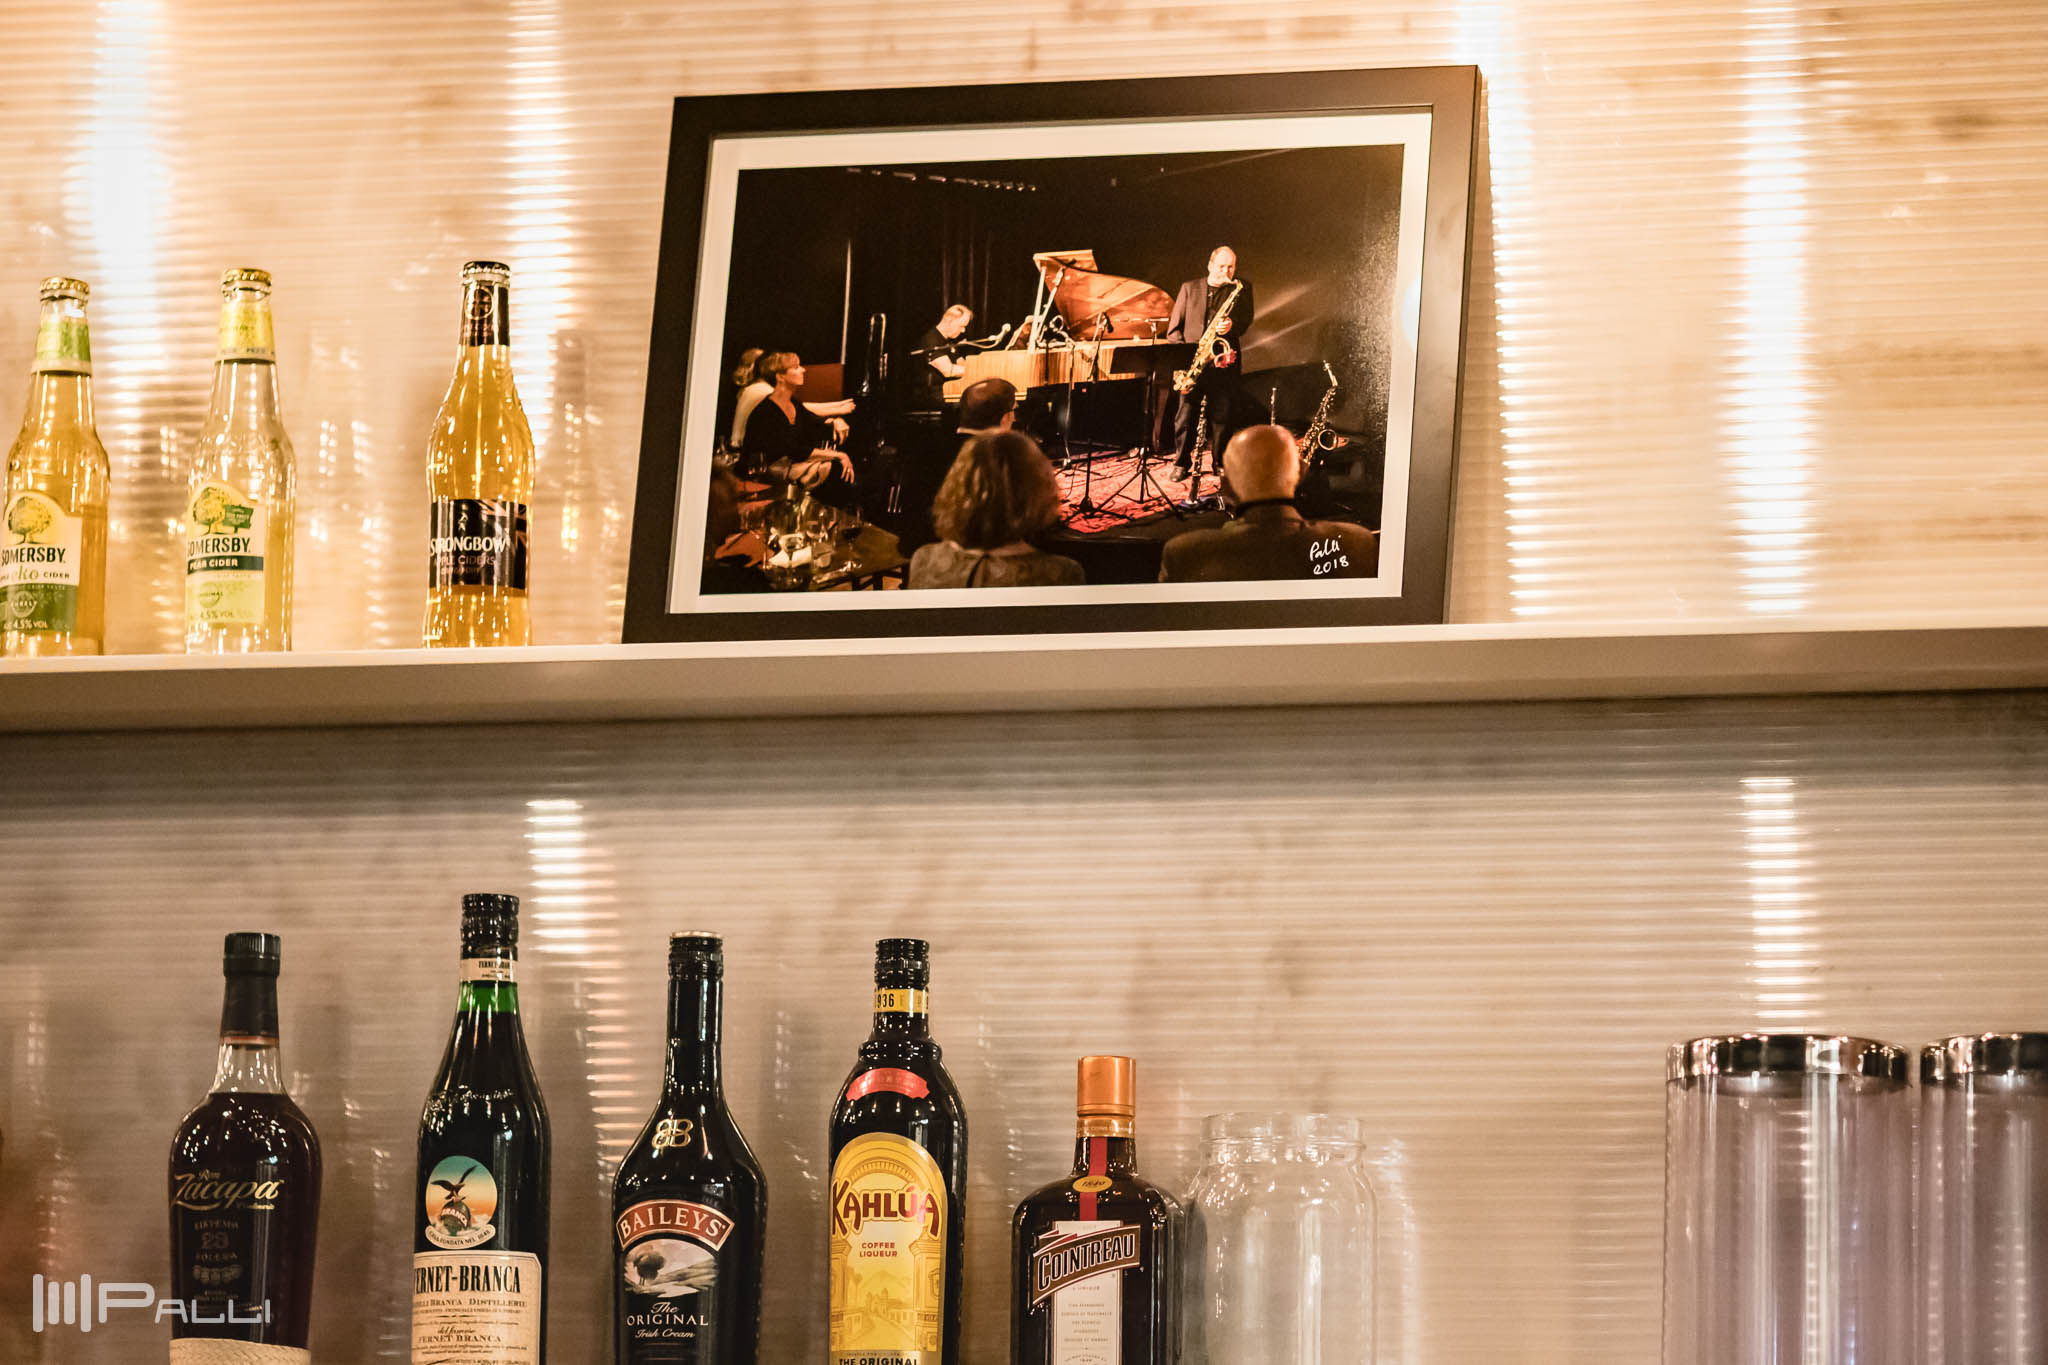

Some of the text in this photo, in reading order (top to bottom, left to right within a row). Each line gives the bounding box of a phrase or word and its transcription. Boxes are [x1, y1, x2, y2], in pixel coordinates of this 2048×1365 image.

[430, 536, 506, 556] STRONGBOW
[208, 558, 239, 567] CIDER
[1313, 555, 1349, 575] 2018
[832, 1179, 940, 1237] KAHLÚA
[620, 1206, 724, 1241] BAILEYS
[859, 1250, 898, 1258] LIQUEUR
[1038, 1233, 1136, 1292] COINTREAU
[650, 1301, 680, 1315] The
[626, 1314, 709, 1327] ORIGINAL
[634, 1328, 696, 1339] Irish Cream
